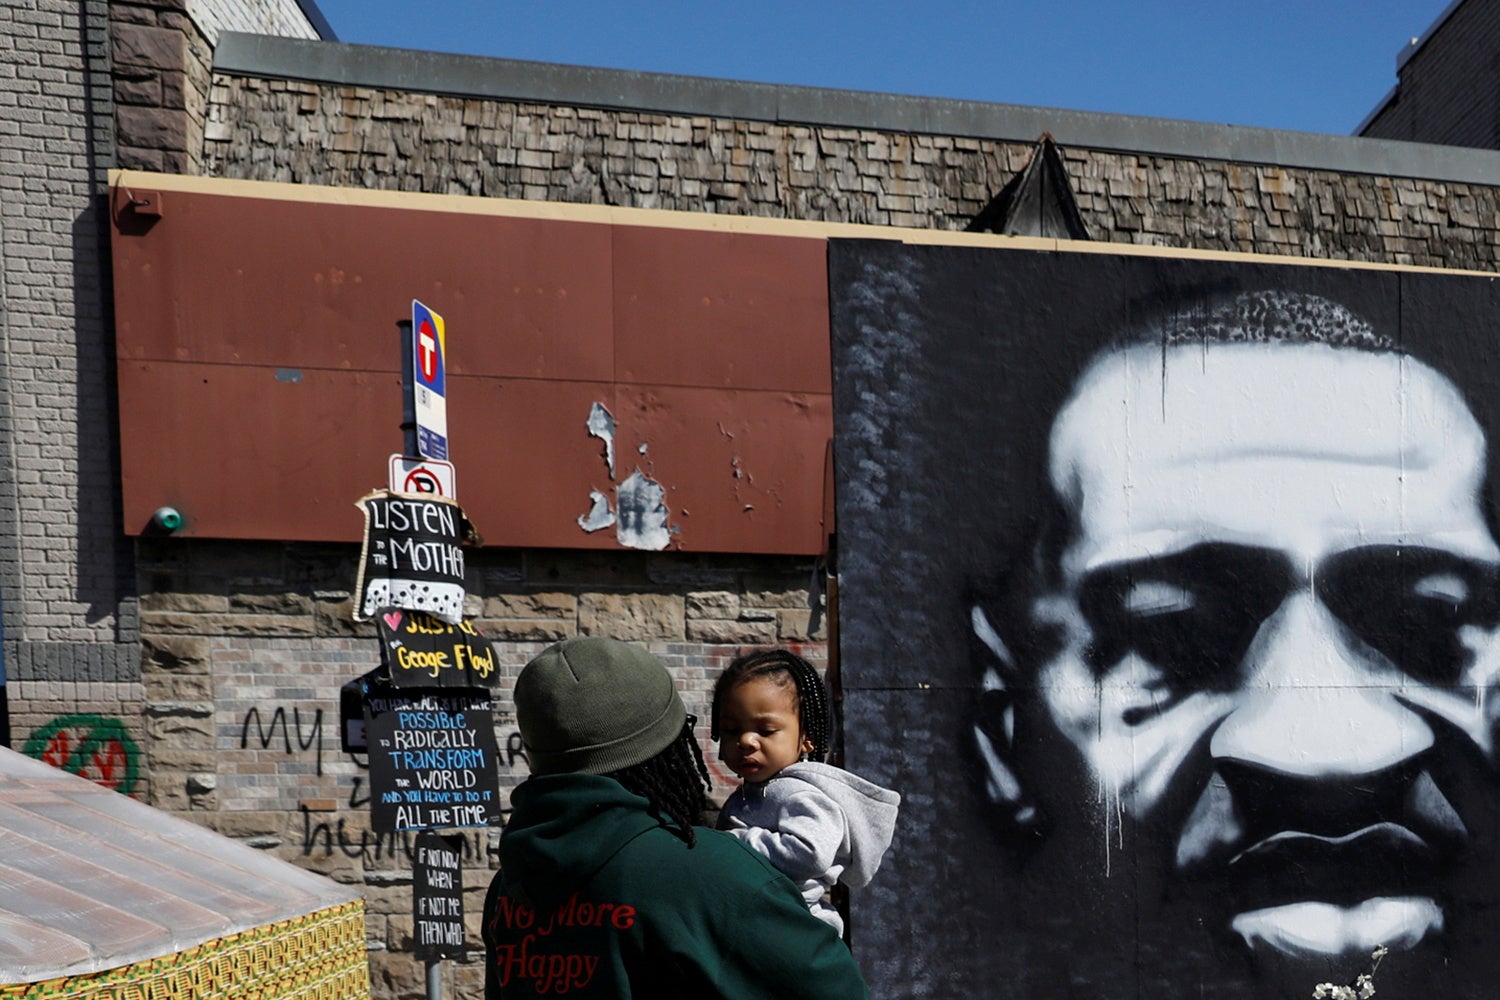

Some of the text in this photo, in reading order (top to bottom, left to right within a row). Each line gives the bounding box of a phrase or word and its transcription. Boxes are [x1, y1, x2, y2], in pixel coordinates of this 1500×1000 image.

[453, 644, 494, 679] Floyd
[416, 769, 476, 789] WORLD
[382, 791, 402, 803] AND
[404, 790, 422, 803] YOU
[453, 792, 463, 802] TO
[466, 793, 479, 802] DO
[483, 790, 492, 801] IT
[395, 805, 427, 829] ALL
[419, 847, 459, 870] IF NOT NOW
[419, 897, 426, 915] IF
[428, 897, 446, 916] NOT
[489, 889, 637, 937] No More
[496, 933, 601, 995] Happy
